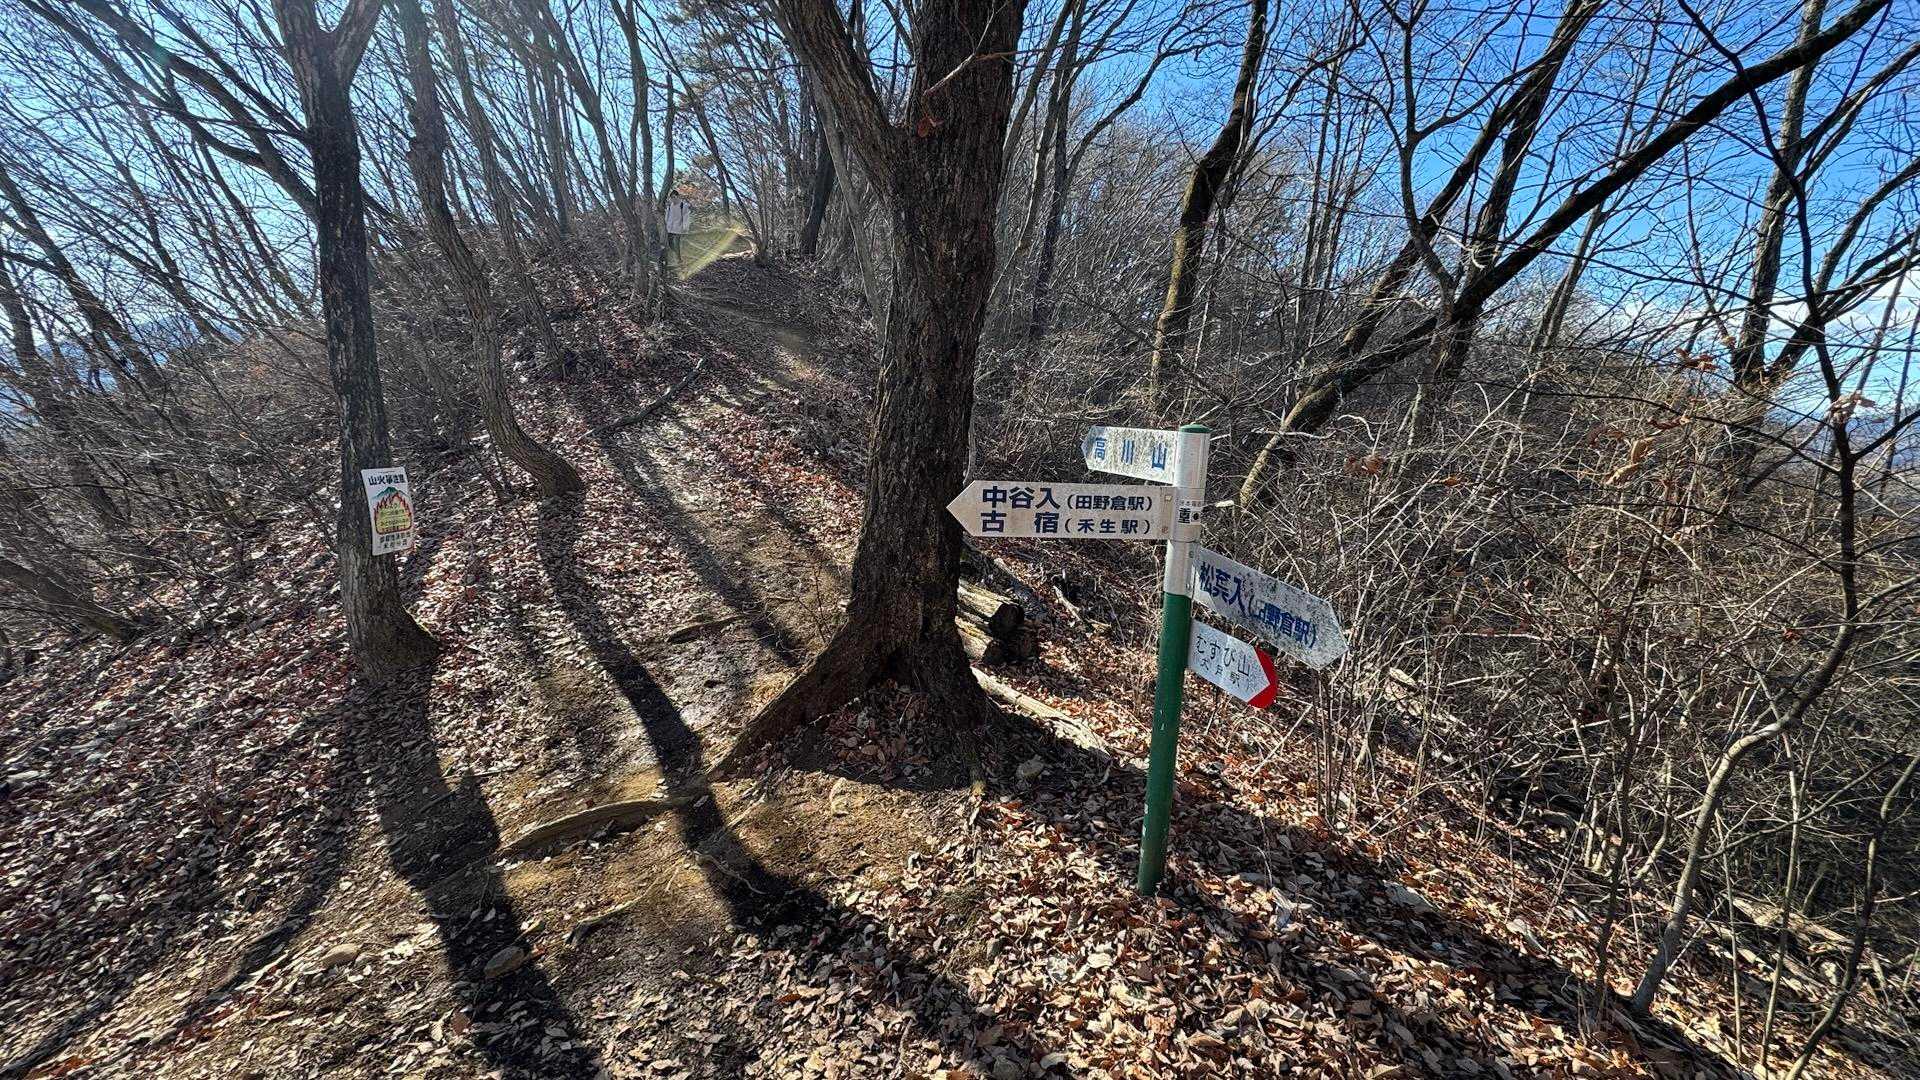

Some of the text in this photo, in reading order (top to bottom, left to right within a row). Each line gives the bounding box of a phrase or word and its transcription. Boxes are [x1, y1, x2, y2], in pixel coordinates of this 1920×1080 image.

[1094, 437, 1168, 471] 高川山
[1196, 635, 1251, 677] むすび山
